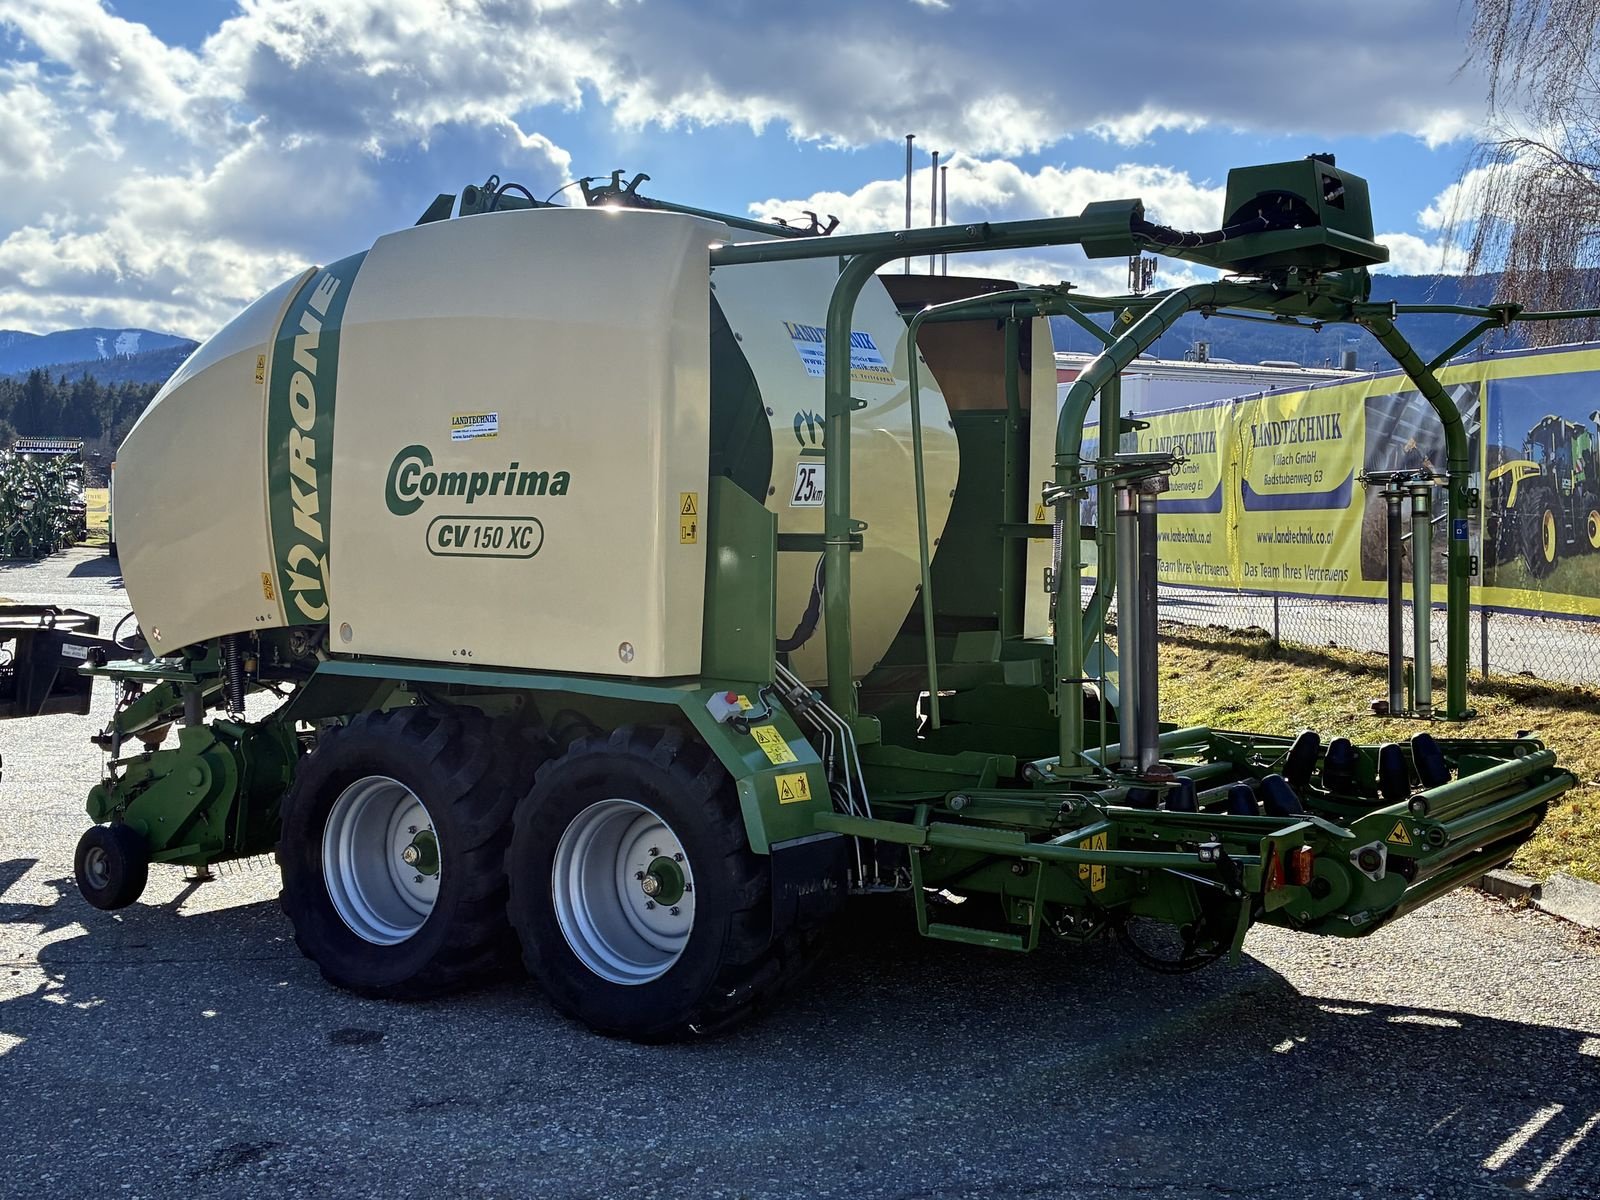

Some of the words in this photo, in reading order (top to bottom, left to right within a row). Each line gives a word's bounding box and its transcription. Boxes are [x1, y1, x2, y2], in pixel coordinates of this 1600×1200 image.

[783, 320, 877, 350] LANDTNIK
[289, 272, 341, 542] KRONE
[452, 414, 497, 425] LANDTECHNIK
[1251, 413, 1342, 448] LANDTECHNIK
[1149, 431, 1217, 455] LANDTECHNIK
[1295, 451, 1317, 465] GmbH
[385, 444, 571, 516] Comprima
[795, 467, 816, 502] 25
[812, 486, 823, 501] km
[1264, 473, 1312, 486] Badstubenweg
[1313, 470, 1323, 483] 63
[438, 525, 471, 547] CV
[474, 527, 503, 548] 150
[506, 526, 533, 549] XC
[1177, 559, 1192, 574] Ihres
[1193, 561, 1229, 577] Vertrauens
[1244, 562, 1258, 577] Das
[1260, 562, 1280, 578] Team
[1283, 563, 1302, 579] Ihres
[1304, 564, 1349, 582] Vertrauens
